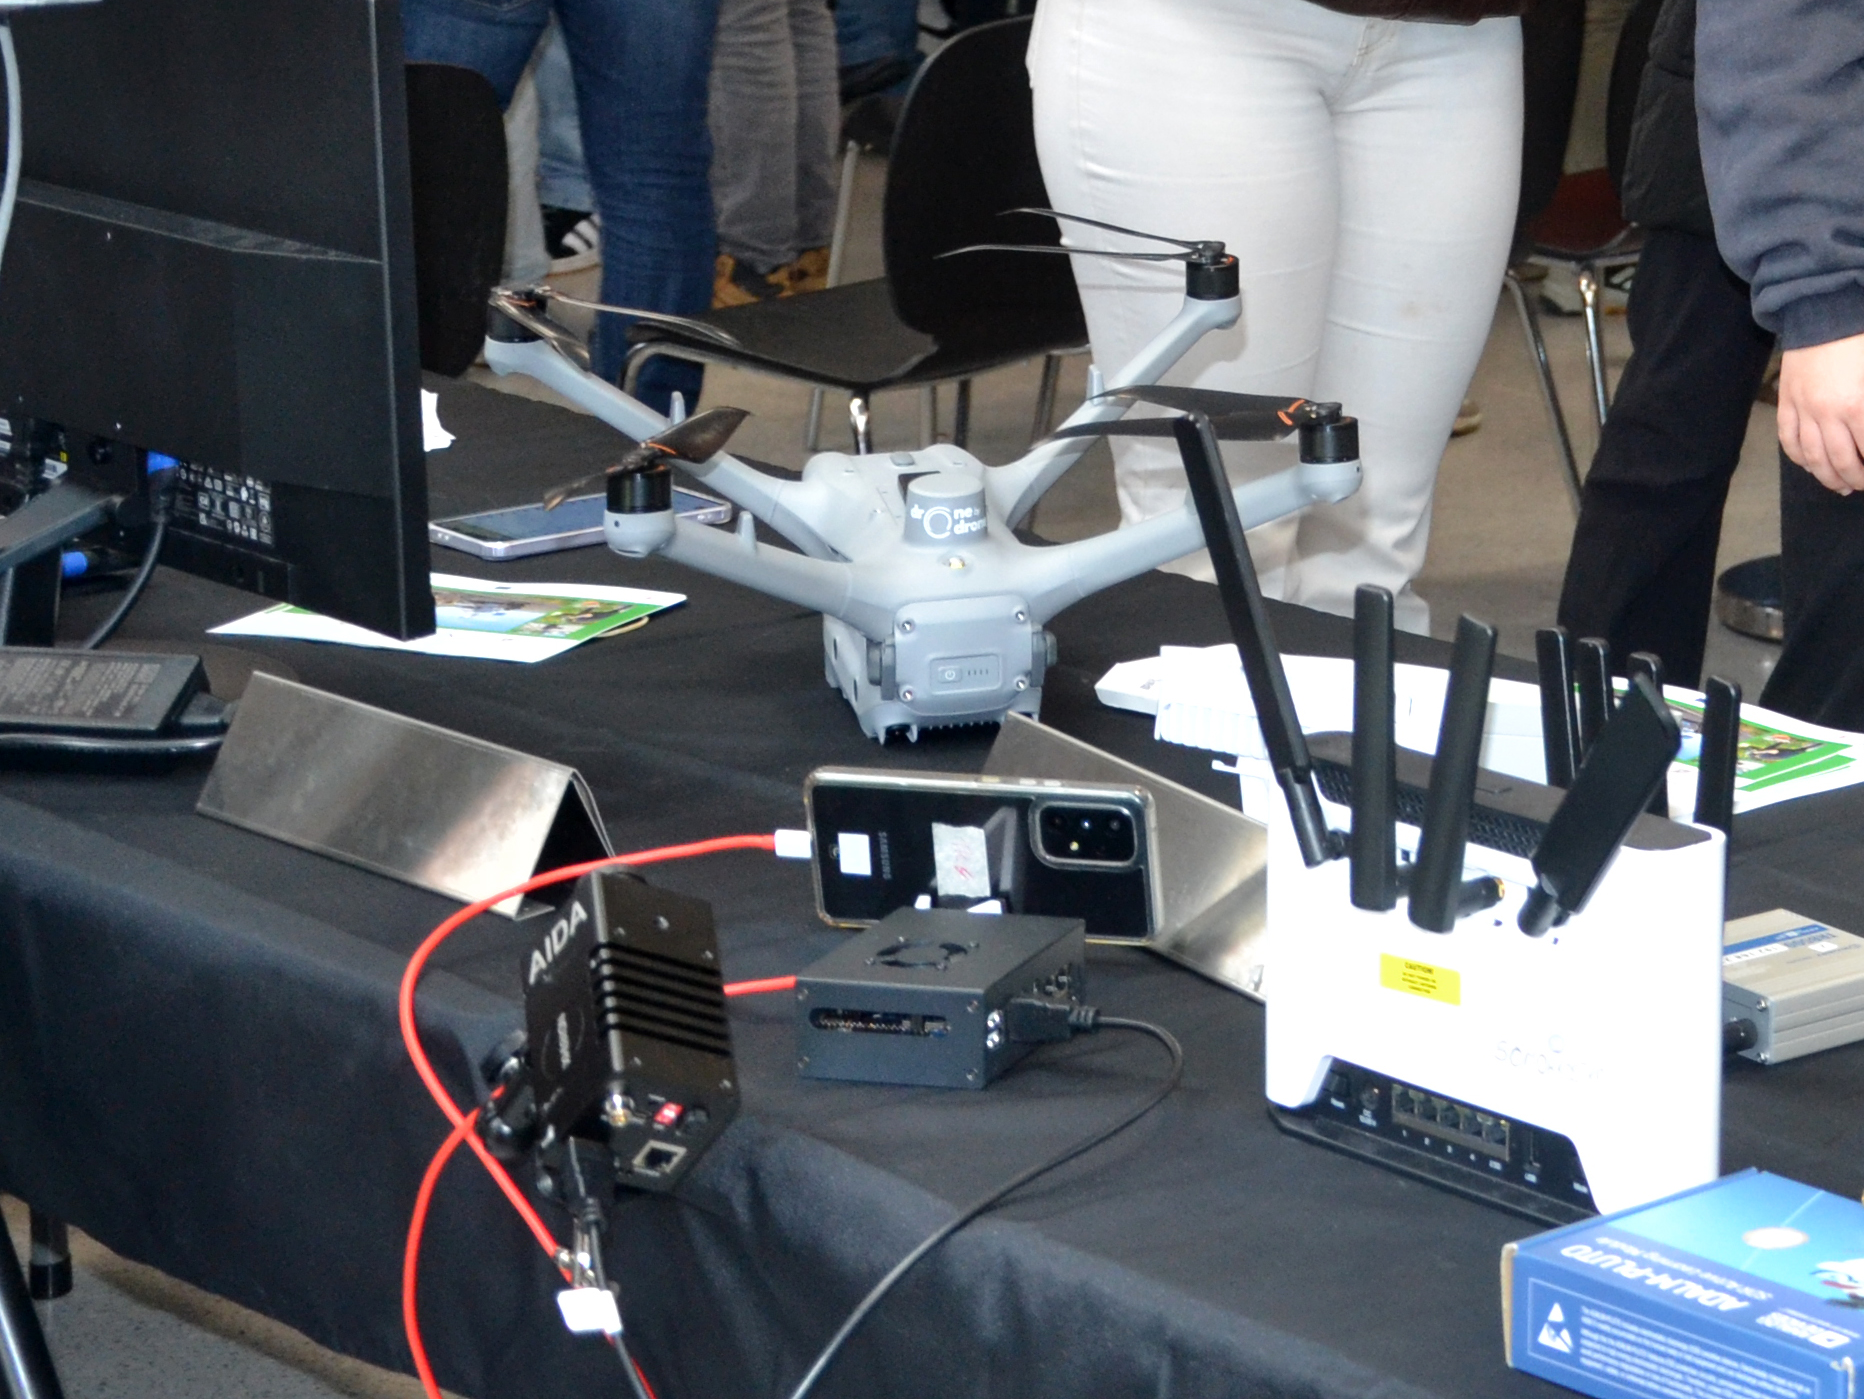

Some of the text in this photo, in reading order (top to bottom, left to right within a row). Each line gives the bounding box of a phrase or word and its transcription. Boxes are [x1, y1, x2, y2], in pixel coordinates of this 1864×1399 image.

[878, 831, 892, 880] SAMSUNG
[529, 901, 588, 985] AIDA
[1560, 1244, 1751, 1311] ADALM-PLUTO
